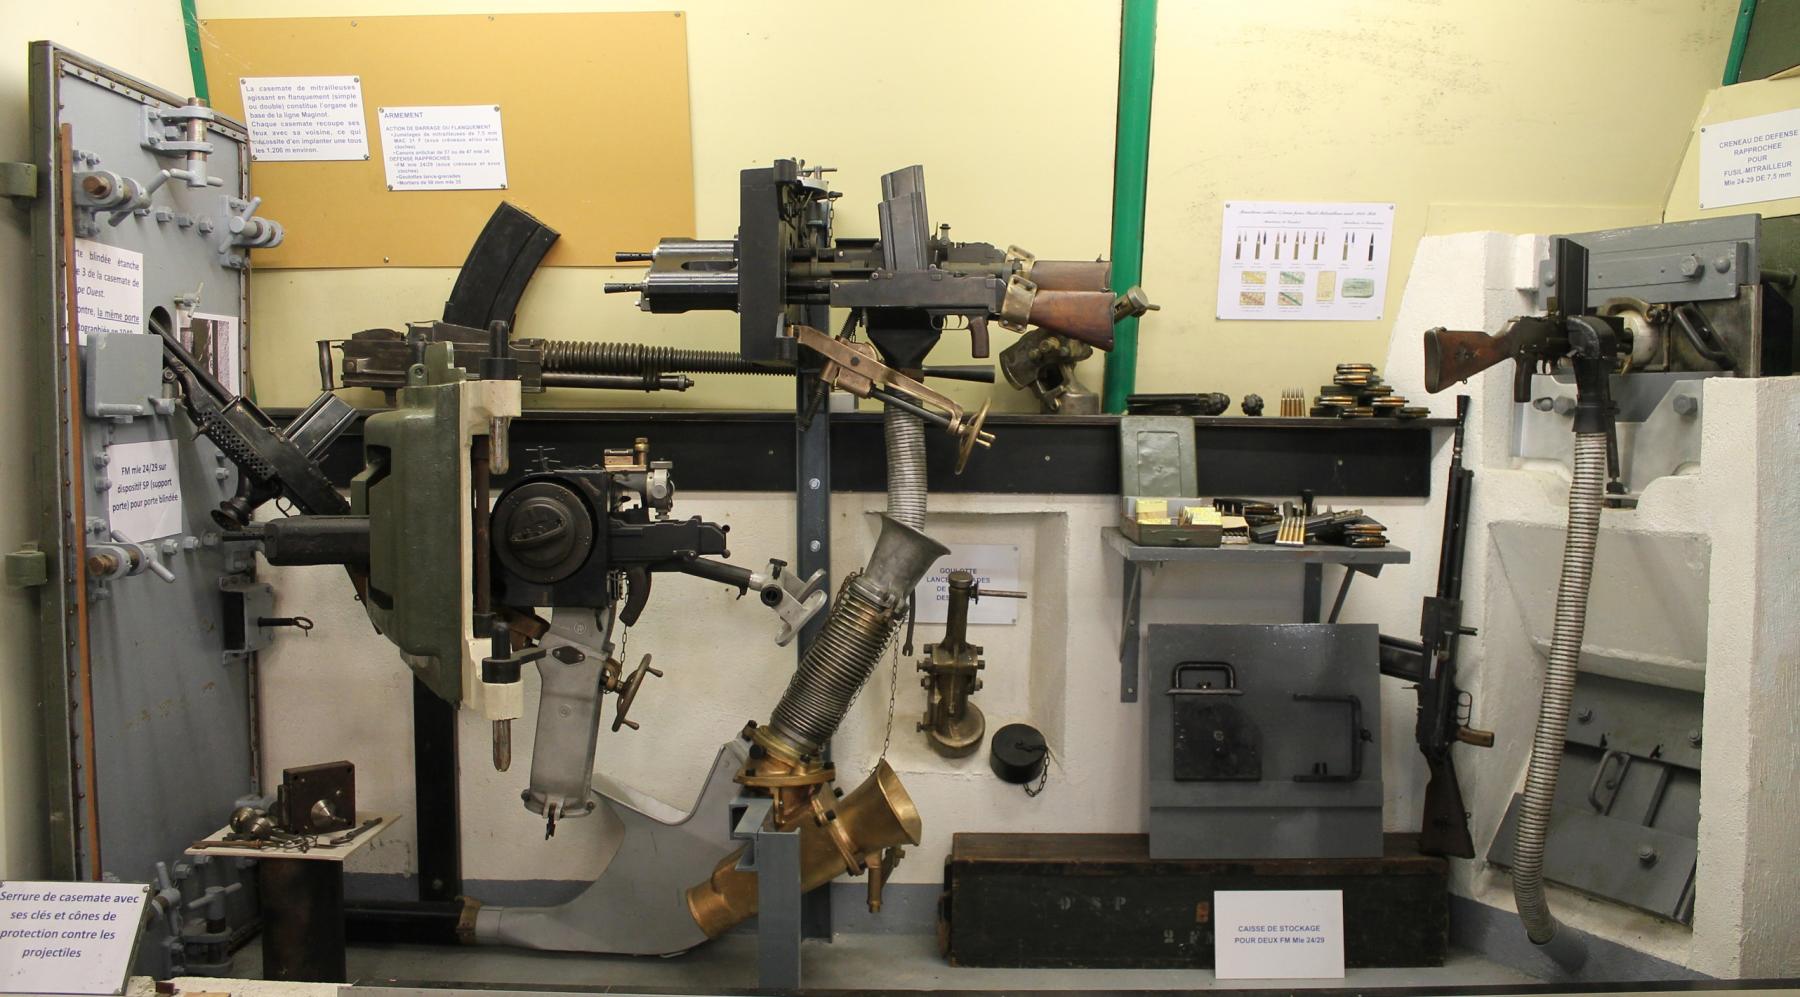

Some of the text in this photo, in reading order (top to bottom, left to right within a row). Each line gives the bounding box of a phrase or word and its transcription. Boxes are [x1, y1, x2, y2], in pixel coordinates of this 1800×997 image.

[1719, 137, 1752, 149] CRENEAU
[1765, 129, 1799, 141] DEFENSE
[1734, 142, 1782, 156] RAPPROCHEE
[1747, 154, 1768, 164] POUR
[89, 251, 111, 264] blindée
[117, 258, 140, 271] étanche
[82, 267, 86, 276] 3
[88, 270, 95, 278] de
[97, 270, 102, 280] la
[104, 274, 131, 286] casemate
[132, 278, 139, 288] de
[97, 307, 103, 316] la
[105, 310, 123, 320] même
[124, 314, 140, 323] porte
[122, 467, 130, 475] FM
[132, 465, 141, 474] mle
[118, 478, 172, 493] dispositif SP (support
[112, 493, 178, 513] porte) pour porte blindée
[0, 891, 140, 904] Serrure de casemate avec
[31, 910, 51, 920] clés
[54, 912, 66, 920] et
[68, 910, 100, 921] cônes
[102, 911, 117, 921] de
[0, 928, 116, 941] protection contre les
[22, 947, 81, 959] projectiles
